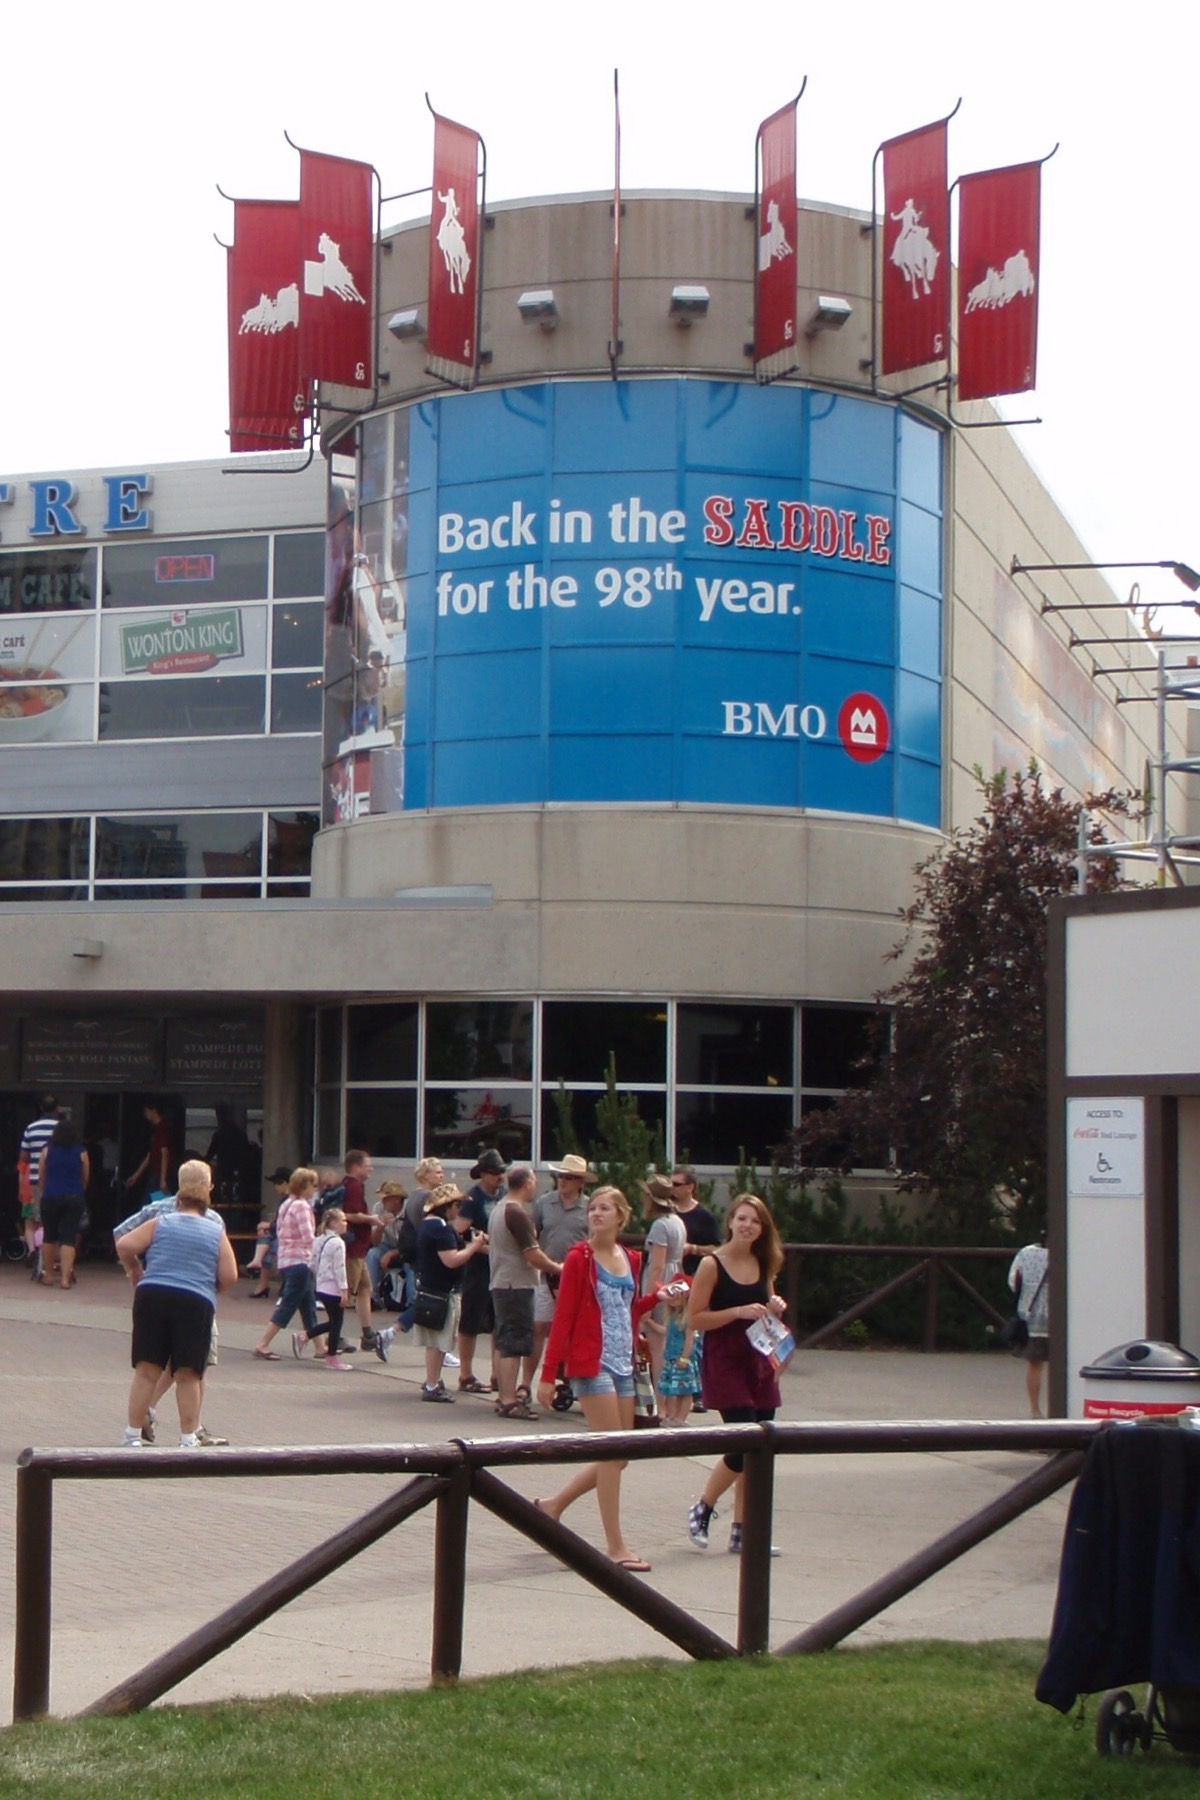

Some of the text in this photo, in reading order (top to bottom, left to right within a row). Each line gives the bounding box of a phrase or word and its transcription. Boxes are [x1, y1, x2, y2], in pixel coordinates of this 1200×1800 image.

[438, 495, 890, 565] Back in the SADDLE
[157, 556, 212, 580] OPEN
[437, 563, 801, 621] for the 98th year.
[128, 621, 233, 658] WONTON KING
[175, 654, 211, 666] Restaurant
[721, 701, 827, 739] BMO
[184, 1043, 243, 1054] STAMPEDE
[80, 1054, 104, 1063] ROLL
[1086, 1110, 1111, 1118] ACCESS
[1113, 1132, 1137, 1140] Lounge
[1089, 1176, 1121, 1184] Restroom
